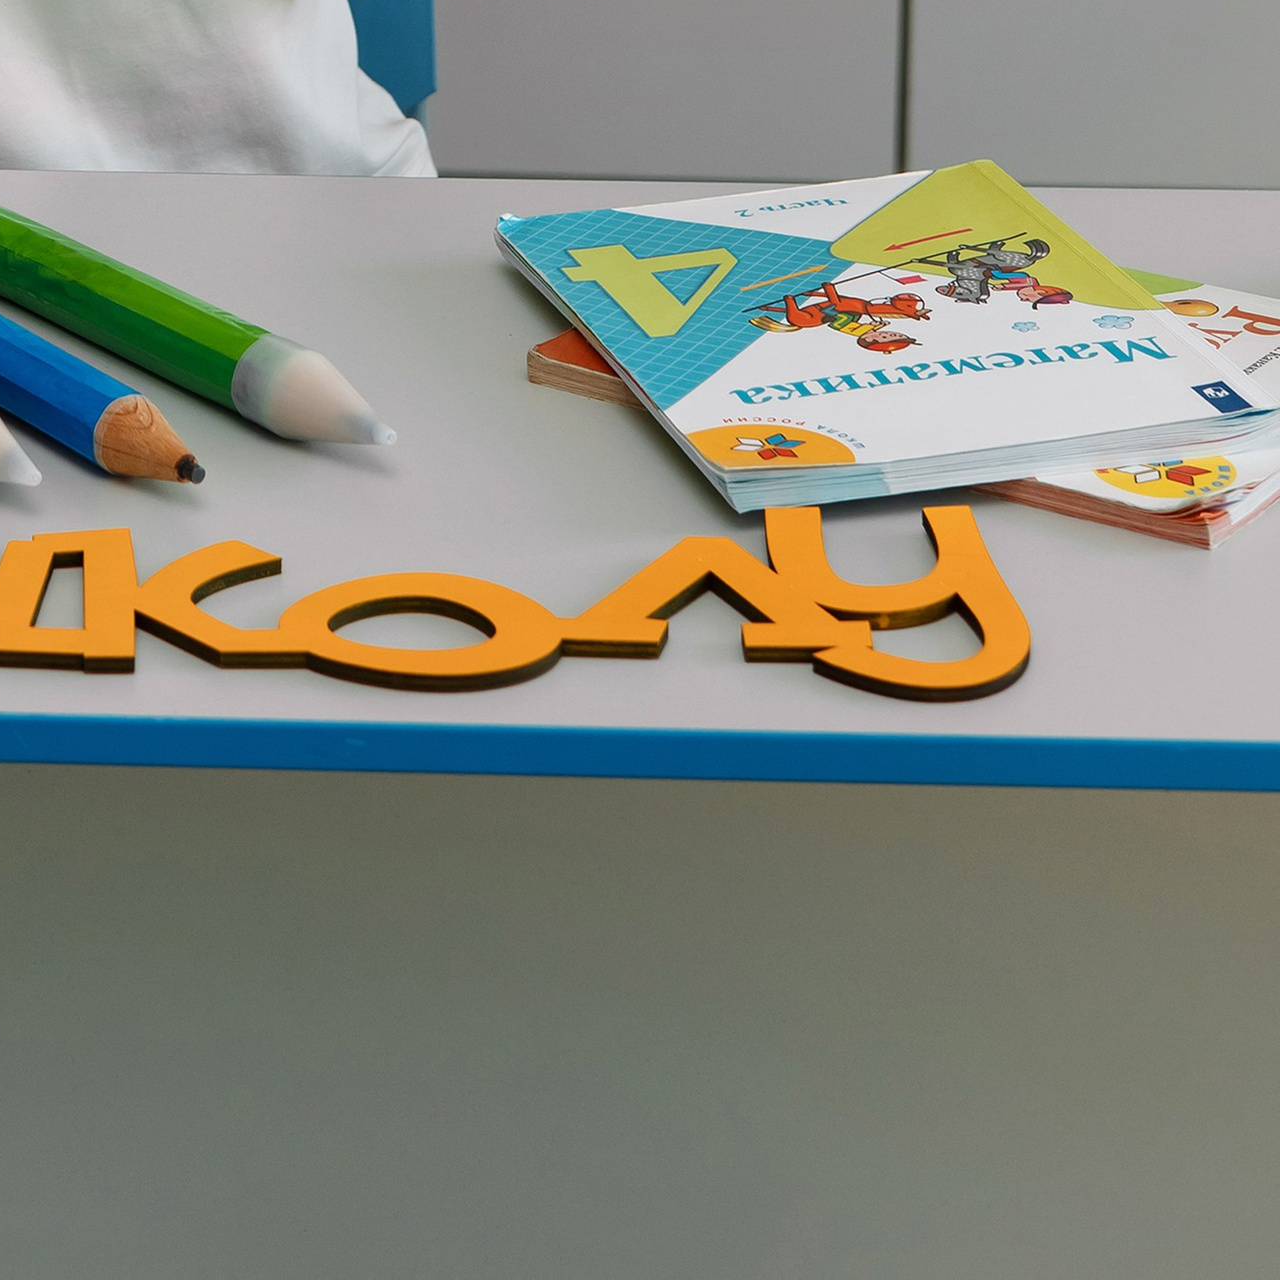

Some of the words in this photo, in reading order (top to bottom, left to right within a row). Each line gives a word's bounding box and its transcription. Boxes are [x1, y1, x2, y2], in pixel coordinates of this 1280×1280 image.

[734, 208, 754, 218] 2
[758, 197, 851, 214] Часть
[560, 244, 739, 338] 4
[728, 336, 1178, 405] Математика
[722, 416, 806, 426] РОССИИ
[816, 424, 866, 449] ШКОЛА
[1183, 465, 1231, 496] ШКОЛА
